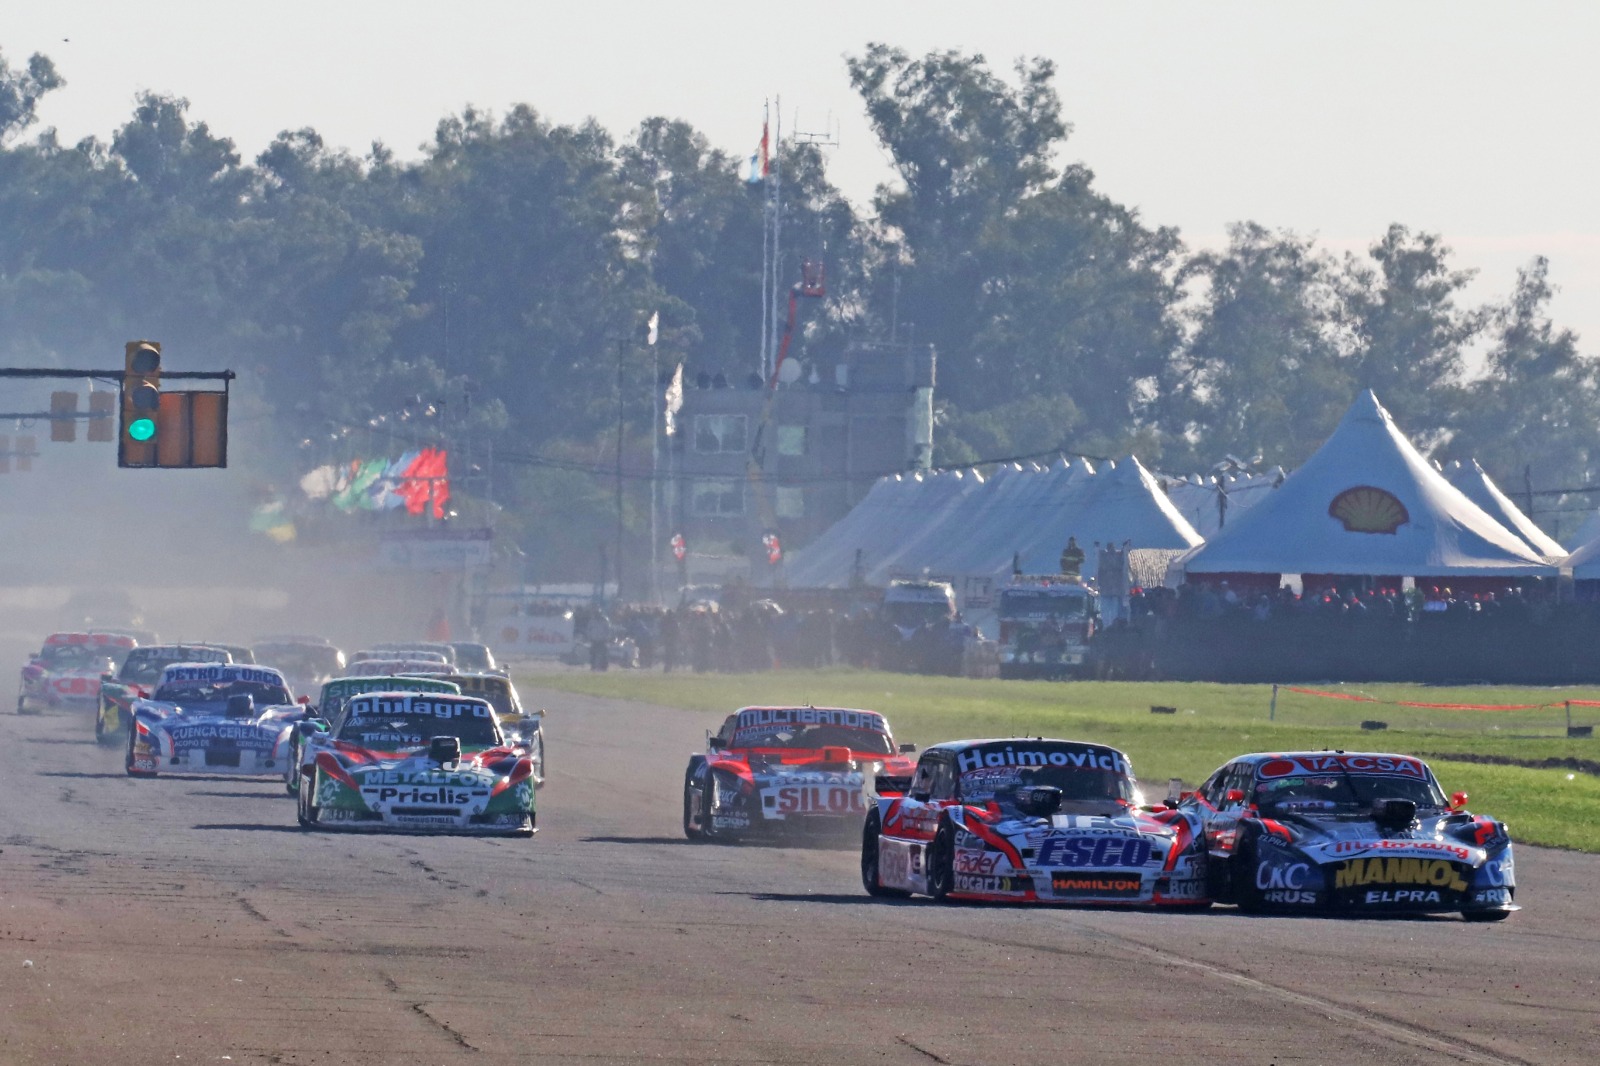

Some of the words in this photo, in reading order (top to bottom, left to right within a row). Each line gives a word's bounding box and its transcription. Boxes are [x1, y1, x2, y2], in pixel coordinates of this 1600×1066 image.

[166, 668, 219, 682] PETRO
[352, 697, 489, 718] philagro
[740, 709, 885, 731] MULTIBANDAS
[172, 726, 216, 739] CUENCA
[361, 732, 421, 743] TRENTO
[957, 746, 1132, 773] Haimovich
[1306, 757, 1418, 775] TACSA
[364, 771, 494, 788] METALFOR
[380, 788, 471, 804] Prialis
[1258, 833, 1290, 847] ELPRA
[1036, 838, 1152, 867] ESCO
[1335, 857, 1469, 892] MANNOL
[1052, 879, 1140, 891] HAMILTON
[1365, 890, 1440, 904] ELPRA
